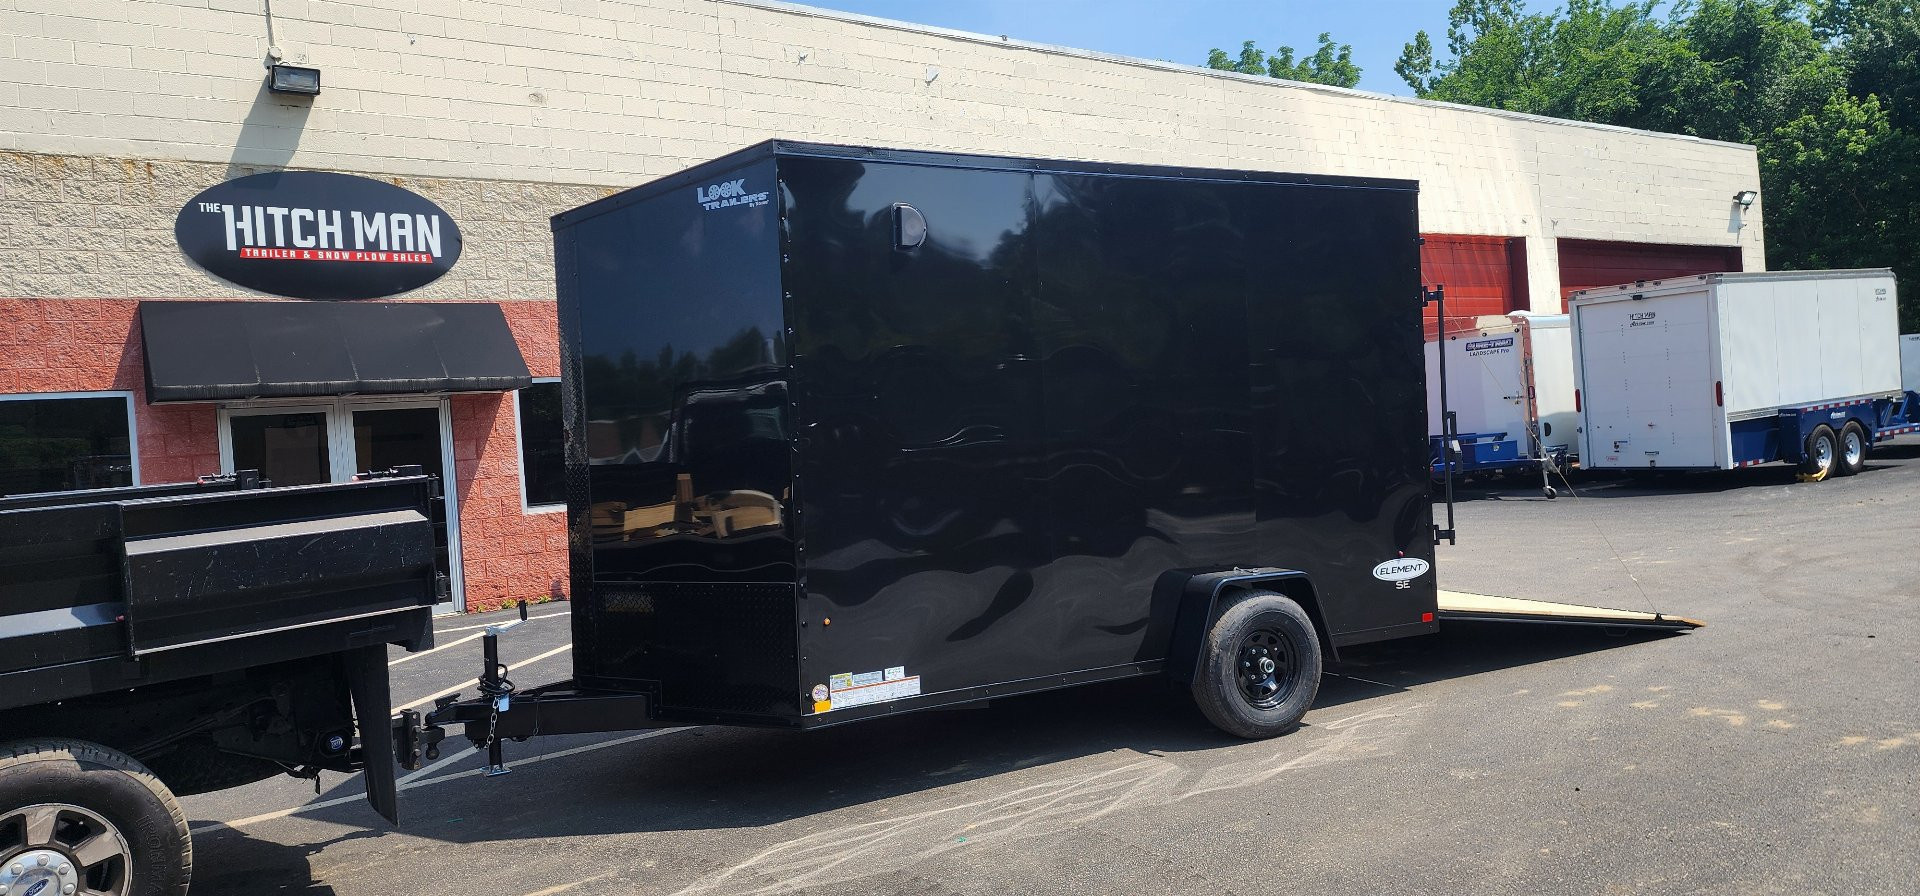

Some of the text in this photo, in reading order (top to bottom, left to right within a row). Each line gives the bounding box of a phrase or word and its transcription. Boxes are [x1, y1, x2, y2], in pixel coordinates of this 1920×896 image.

[696, 178, 746, 204] LOOK
[702, 191, 769, 211] TRAILERS
[198, 202, 442, 258] THE HITCH MAN
[245, 249, 427, 262] TRAILER & SNOW PLOW SALES
[1469, 349, 1499, 357] LANDSCAPE
[1380, 563, 1422, 575] ELEMENT
[1395, 580, 1411, 590] SE
